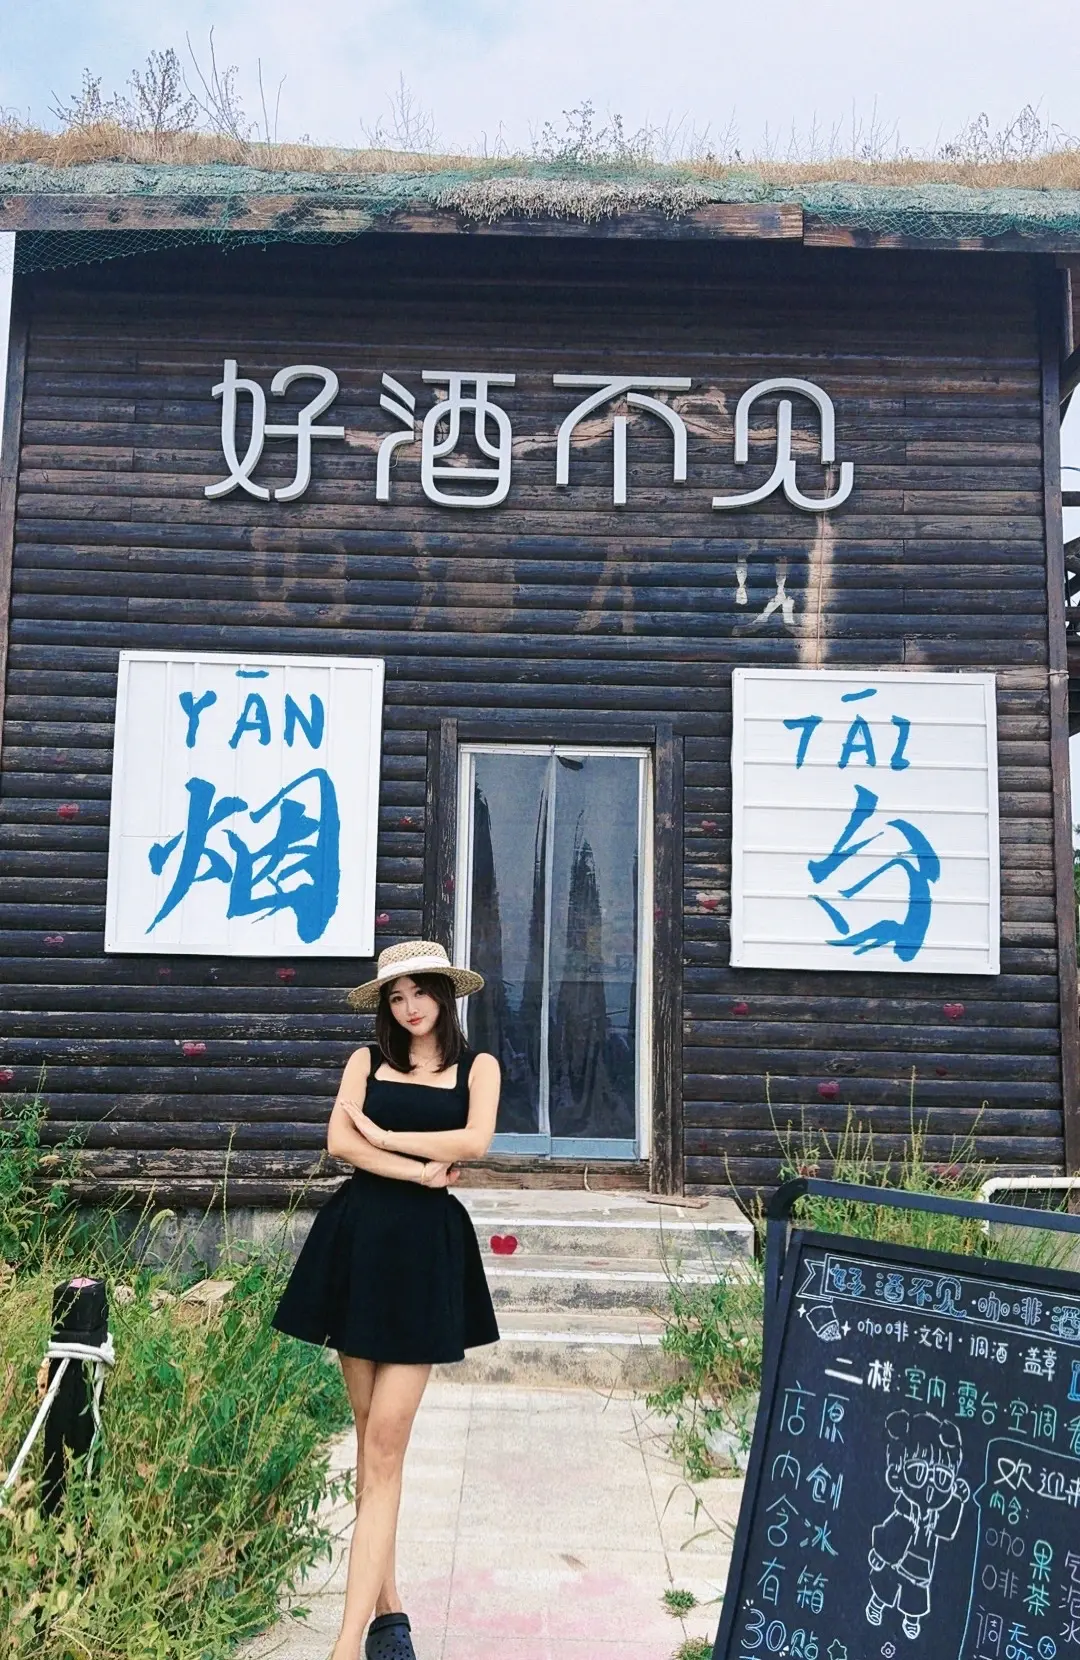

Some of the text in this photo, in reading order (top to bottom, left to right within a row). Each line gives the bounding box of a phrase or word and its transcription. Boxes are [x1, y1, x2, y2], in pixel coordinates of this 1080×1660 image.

[204, 359, 854, 511] 好酒不见
[179, 670, 325, 749] YĀN
[145, 767, 341, 944] 烟
[807, 784, 941, 963] 台
